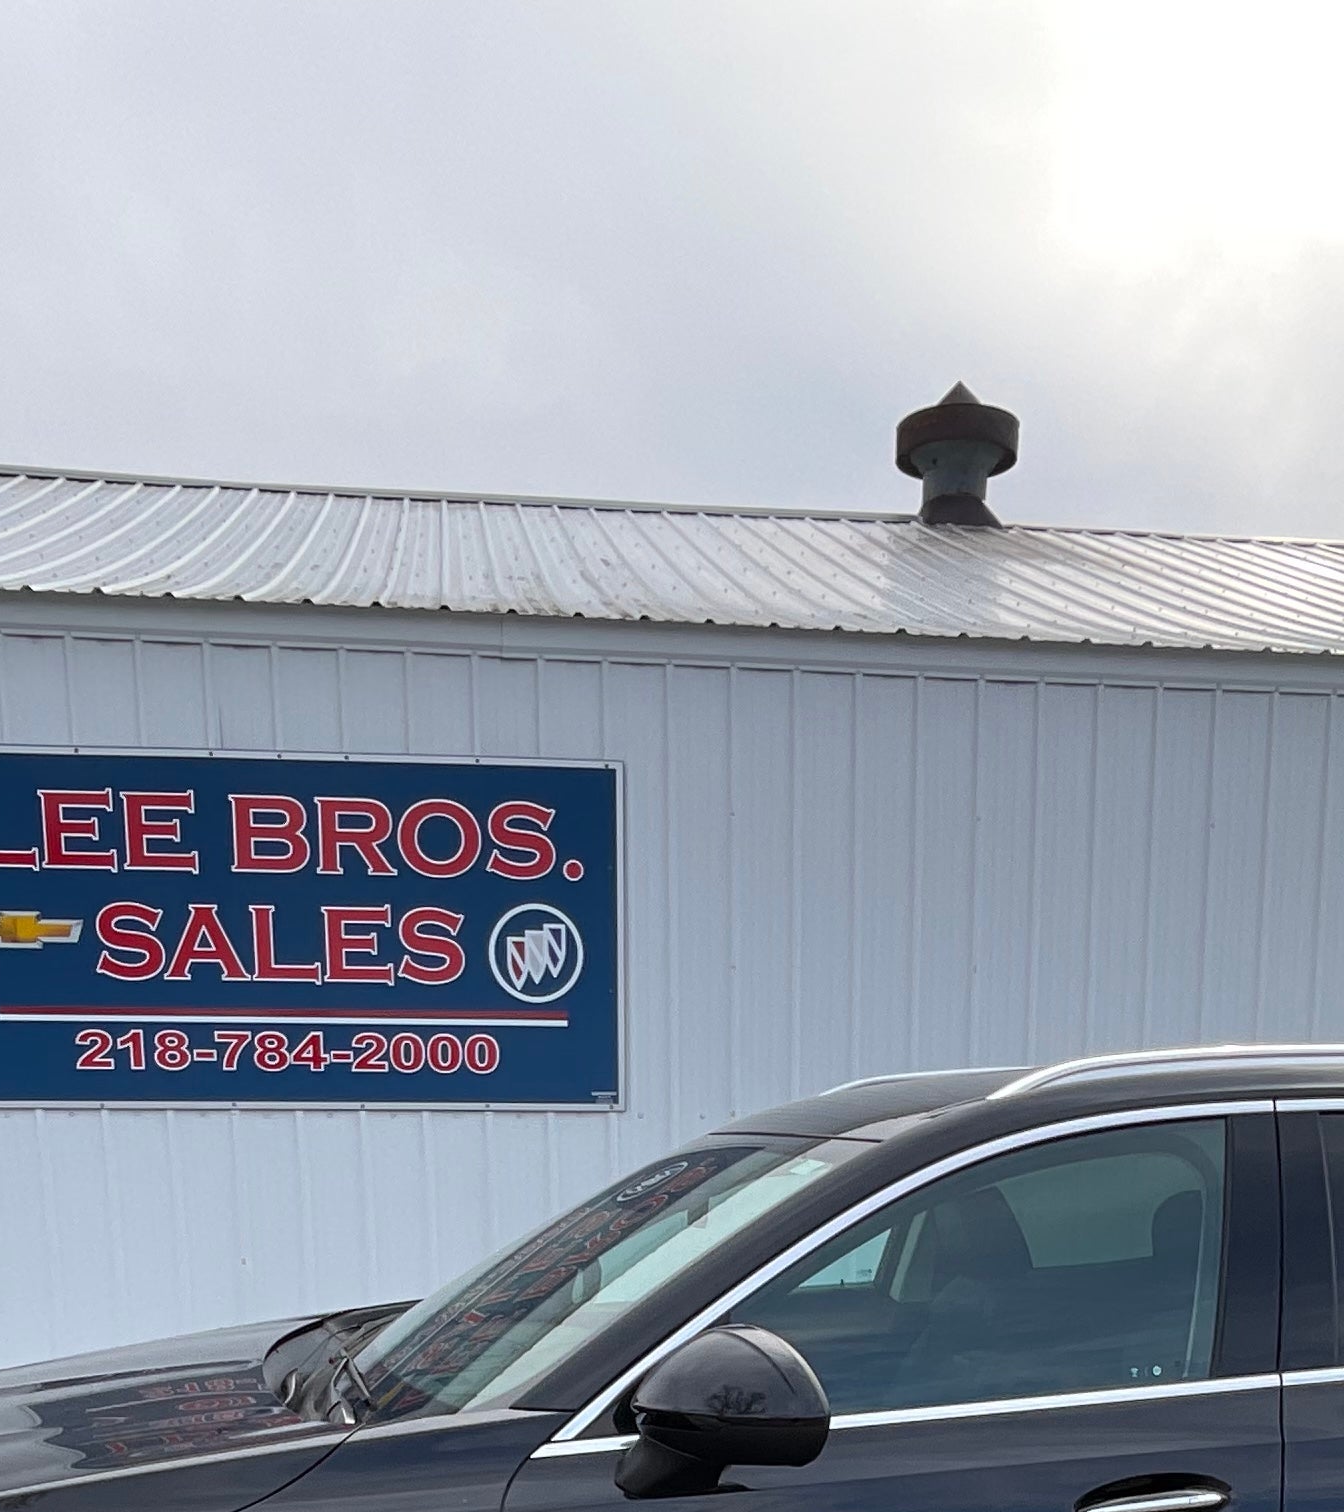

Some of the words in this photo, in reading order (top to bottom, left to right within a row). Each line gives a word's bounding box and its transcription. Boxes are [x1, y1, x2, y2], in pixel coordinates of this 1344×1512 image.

[228, 794, 584, 881] BROS.
[96, 902, 465, 986] SALES
[75, 1029, 499, 1074] 218-784-2000
